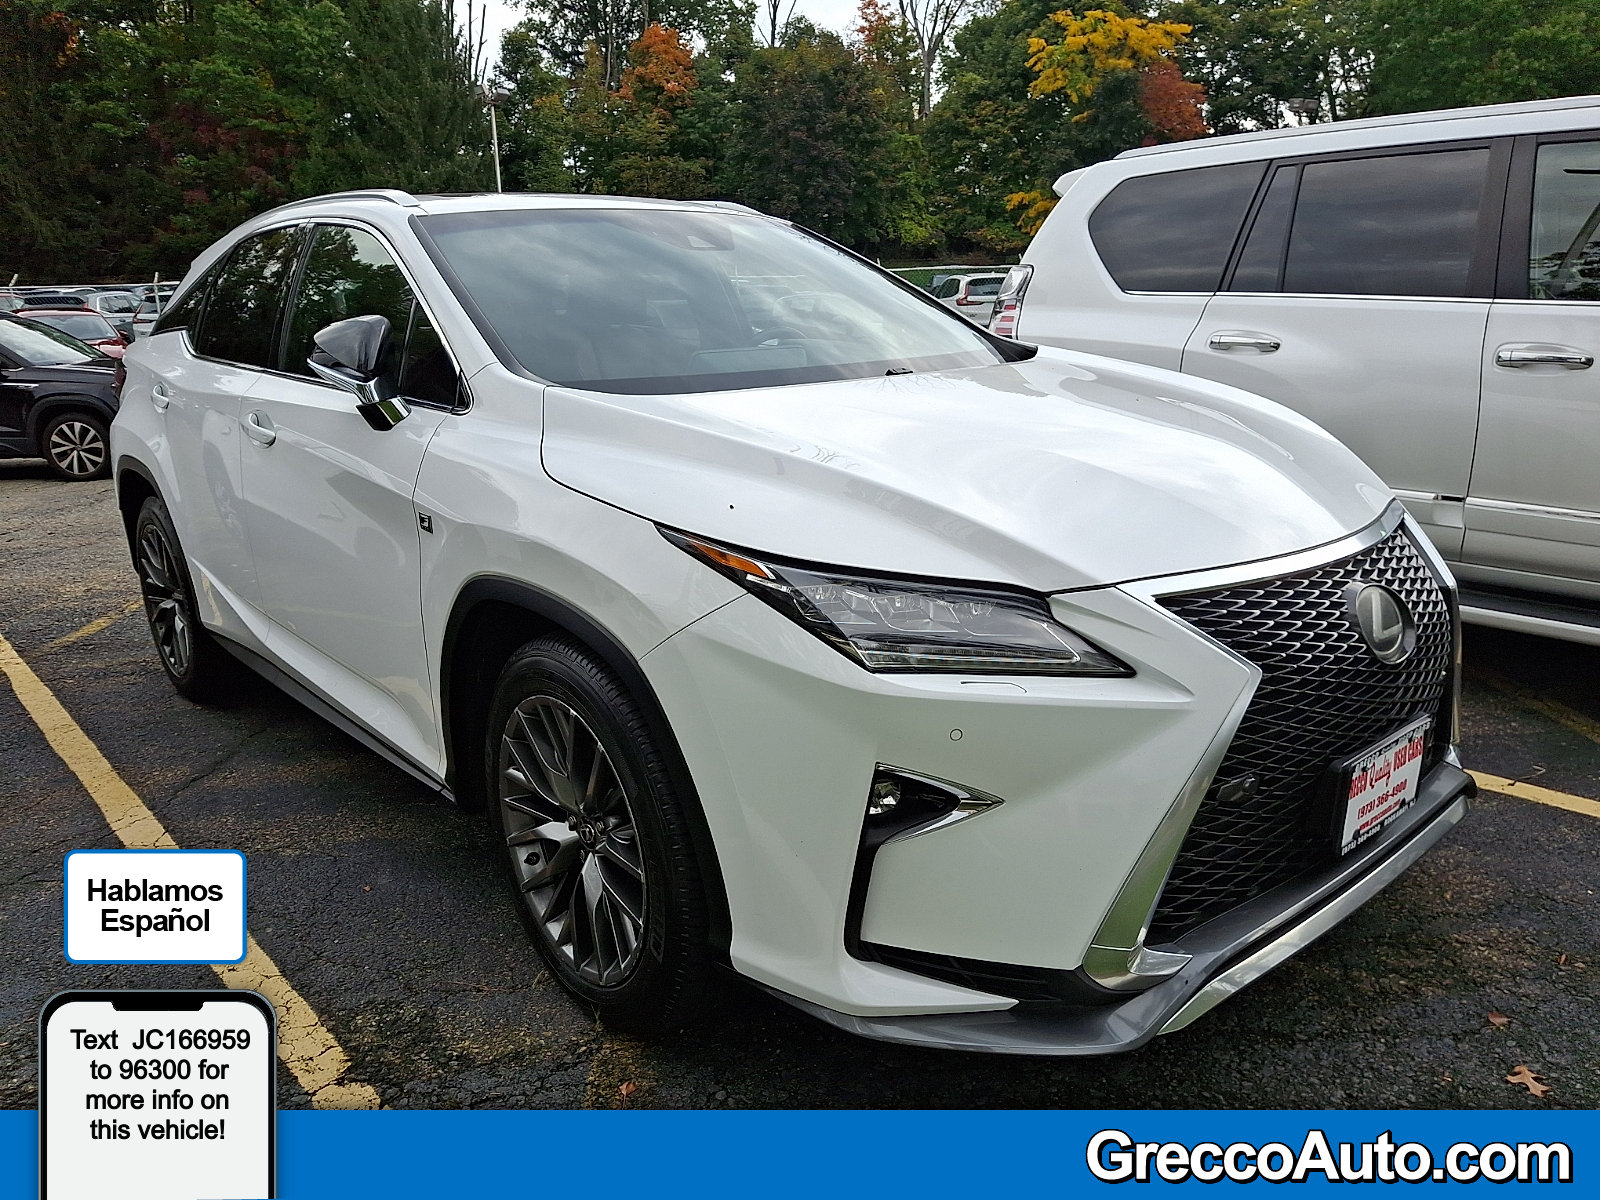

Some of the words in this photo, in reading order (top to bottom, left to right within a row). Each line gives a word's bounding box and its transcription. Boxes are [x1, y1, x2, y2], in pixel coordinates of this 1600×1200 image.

[1394, 745, 1408, 772] USED
[1357, 799, 1376, 820] (973)
[1376, 779, 1408, 808] 366-4900
